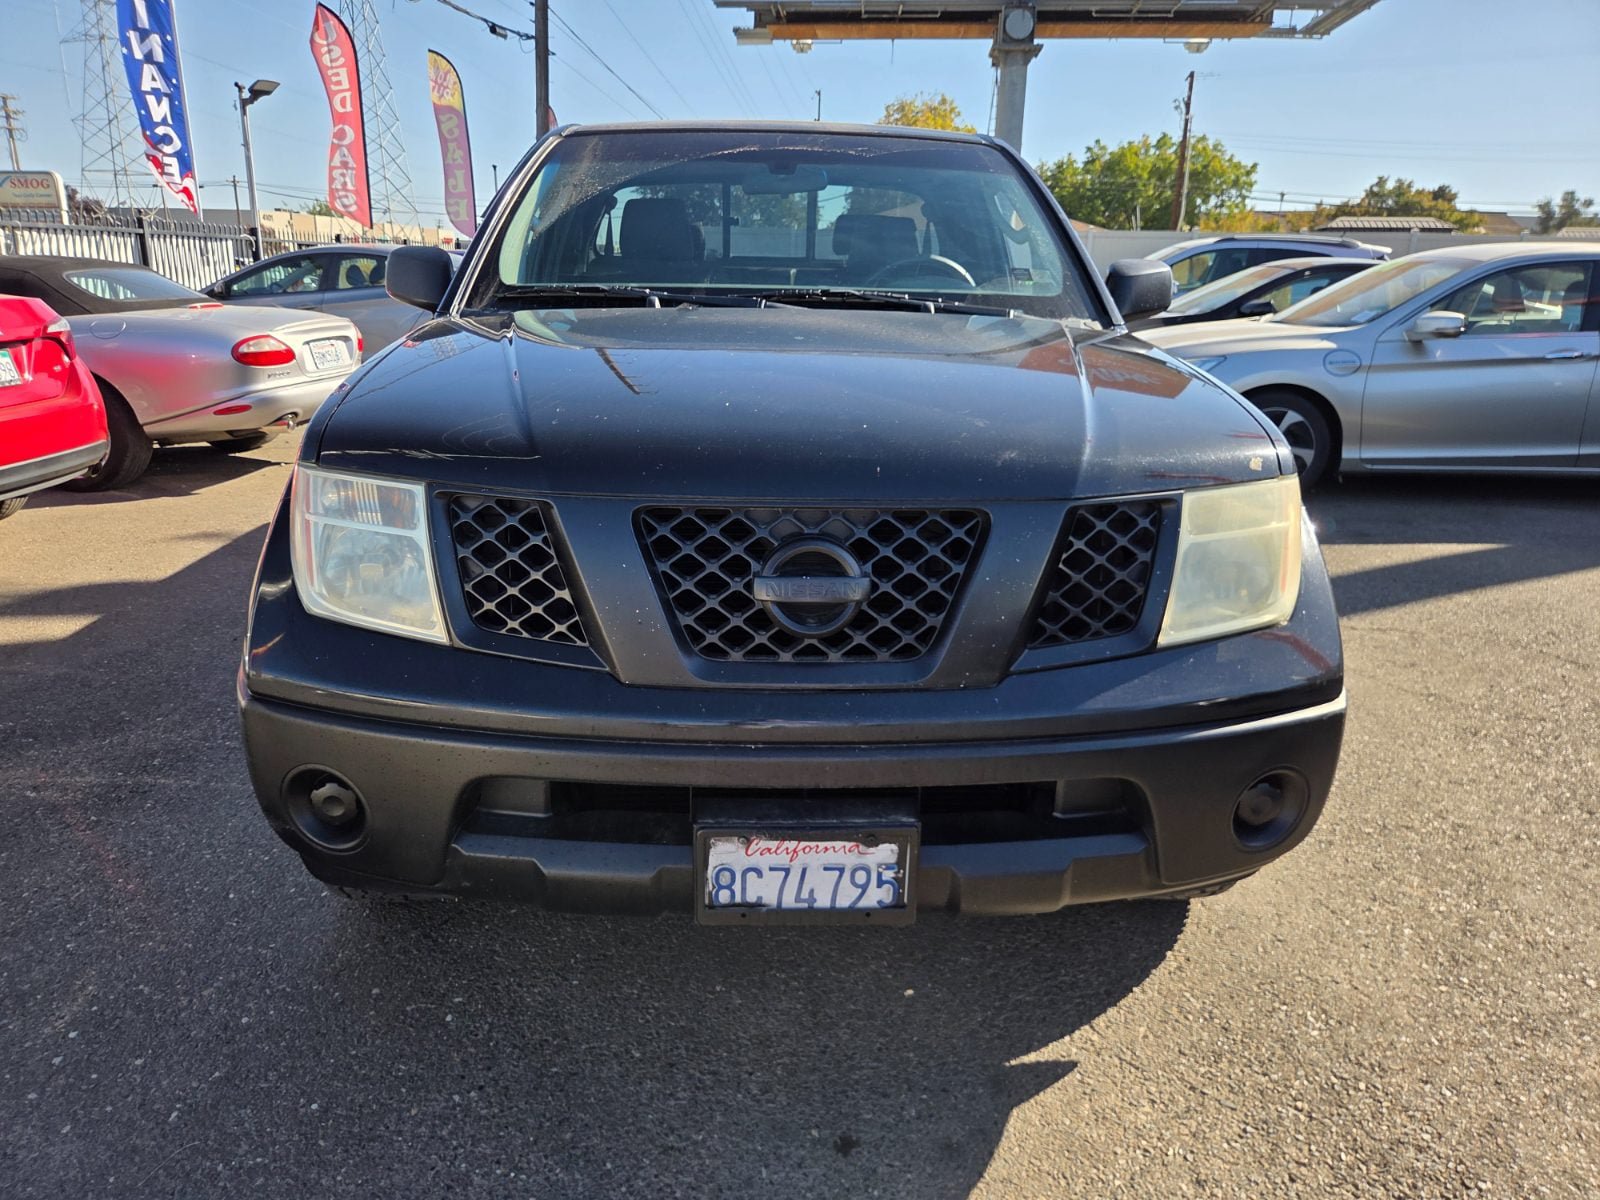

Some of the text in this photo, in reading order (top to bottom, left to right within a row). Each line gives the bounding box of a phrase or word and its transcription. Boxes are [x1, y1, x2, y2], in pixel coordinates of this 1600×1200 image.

[10, 177, 50, 189] SMOG
[765, 582, 859, 598] NISSAN
[744, 838, 875, 863] California
[712, 863, 900, 909] 8C74795
